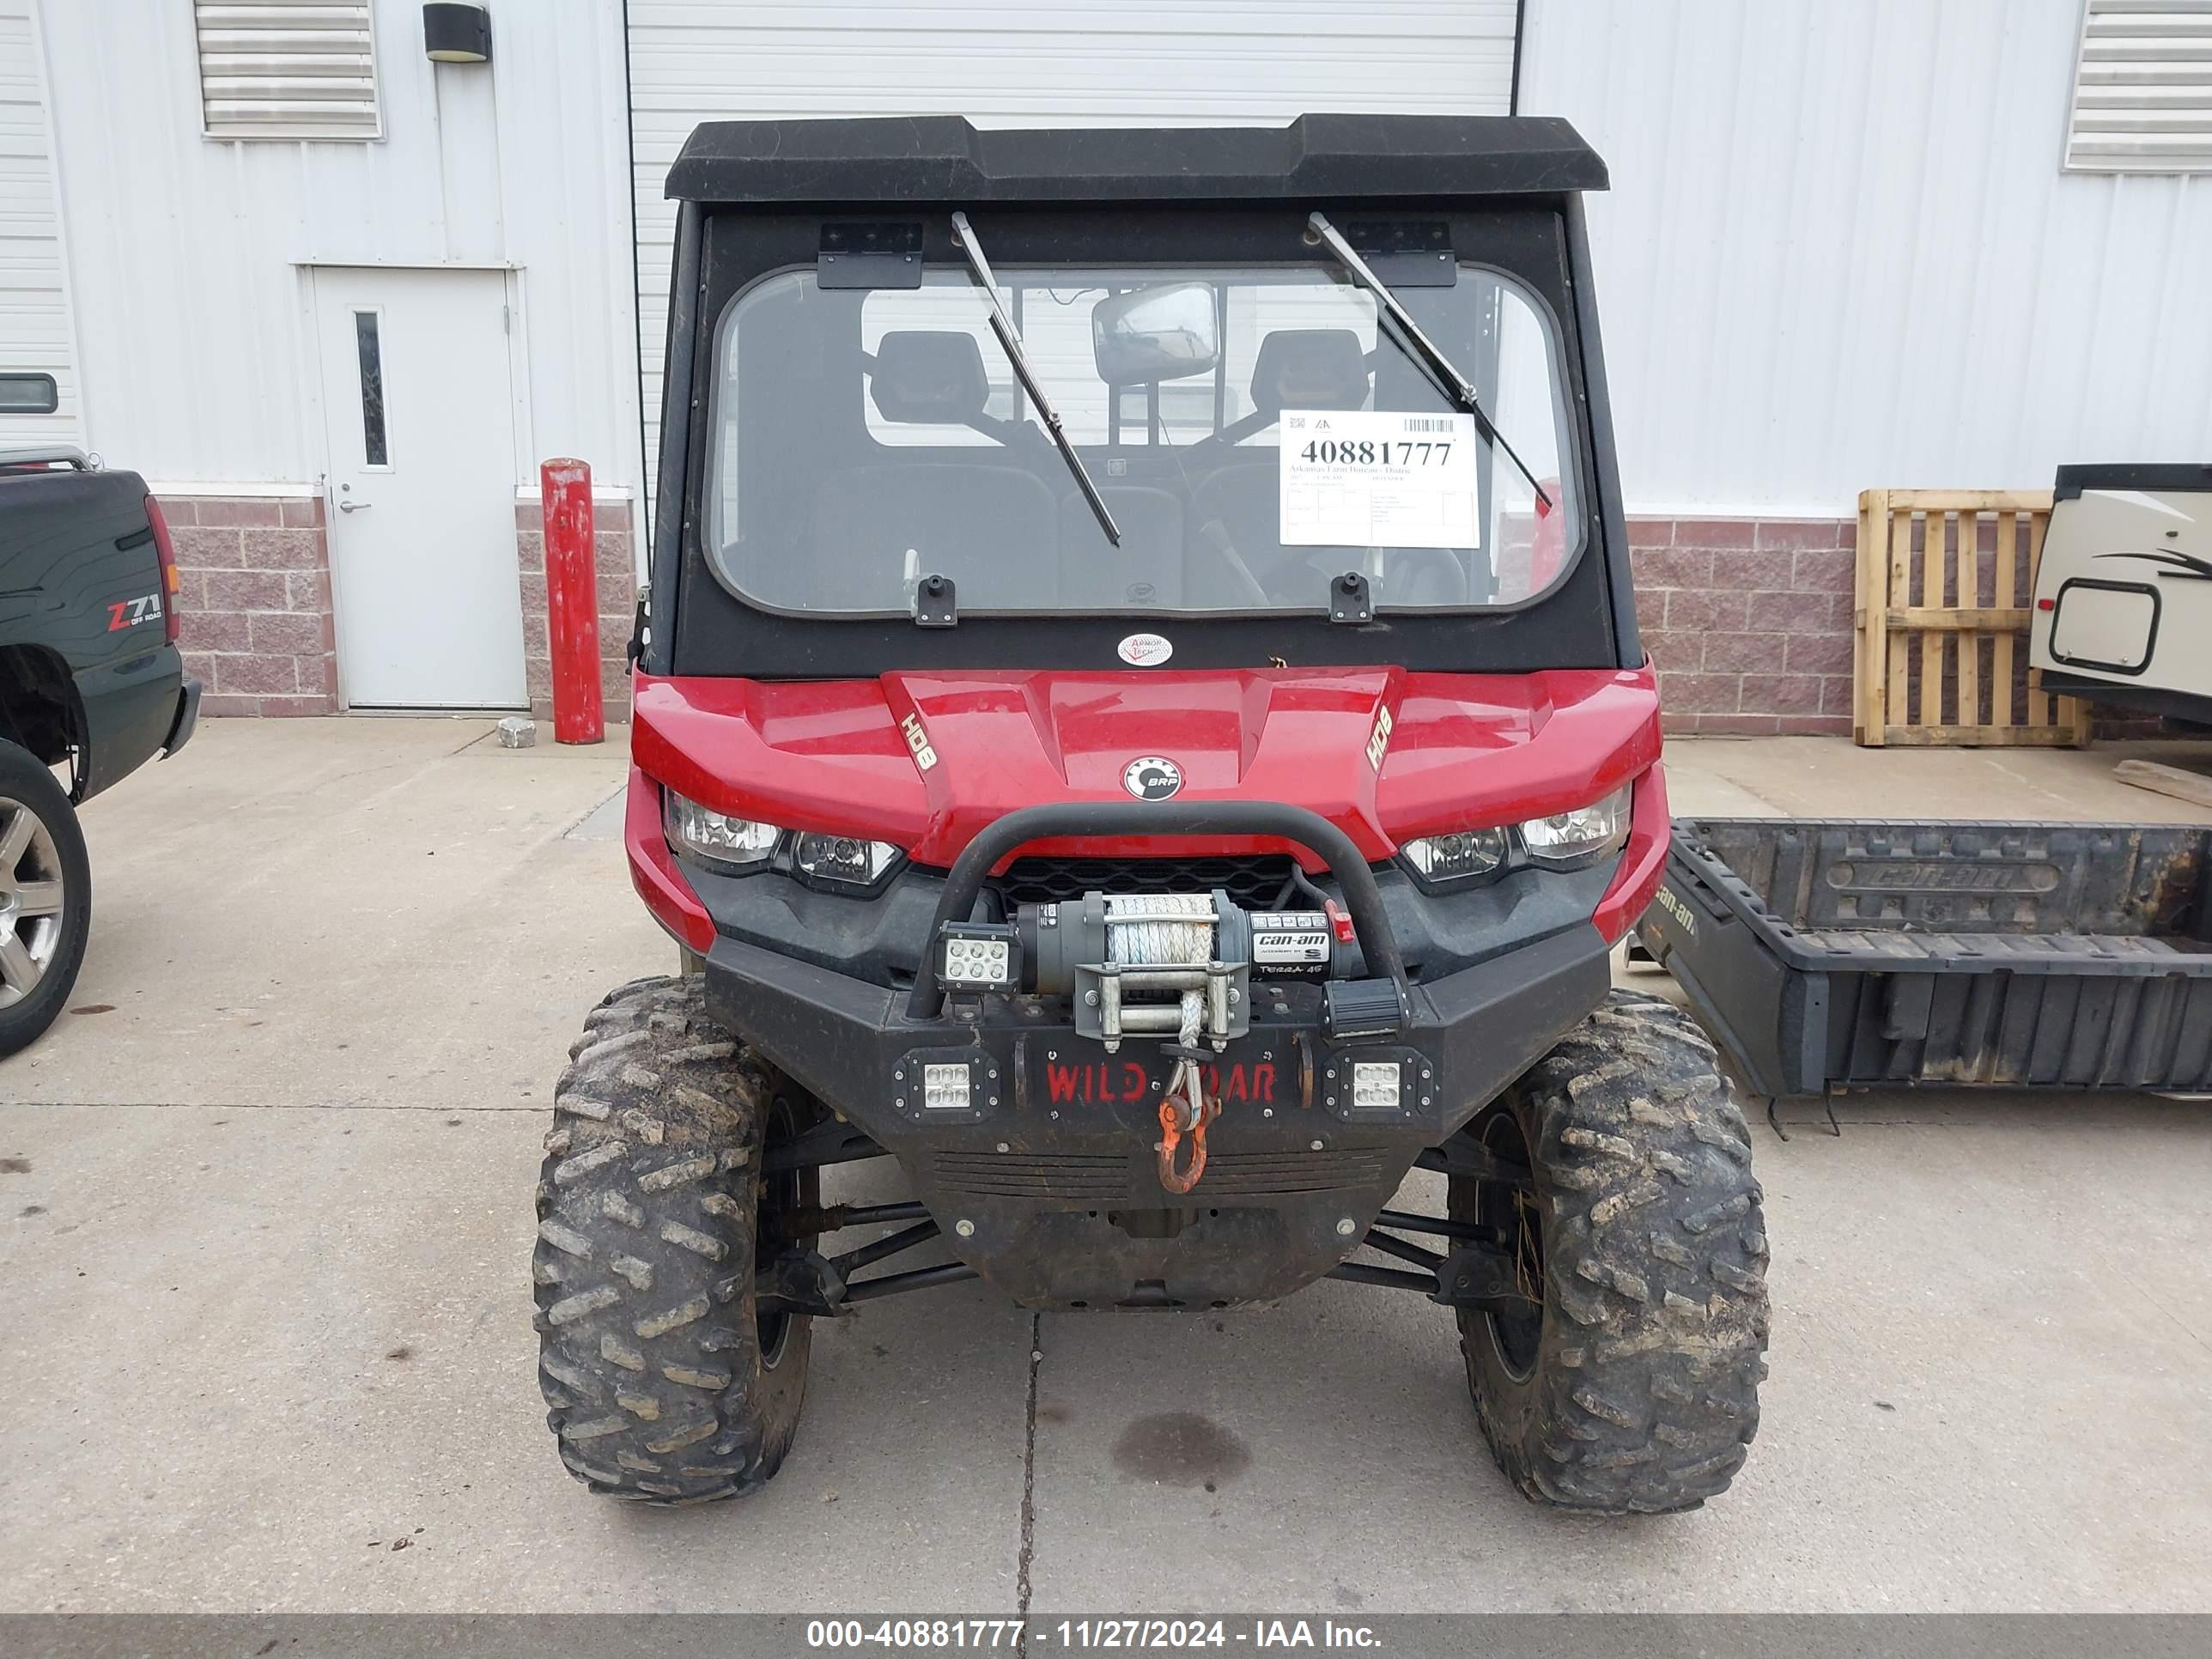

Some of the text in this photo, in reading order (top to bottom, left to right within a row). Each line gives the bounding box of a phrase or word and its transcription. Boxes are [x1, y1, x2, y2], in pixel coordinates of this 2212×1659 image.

[1301, 440, 1451, 465] 40881777
[107, 593, 161, 632] Z71
[131, 611, 161, 626] OFF ROAD
[901, 712, 938, 770] HD8
[1365, 704, 1393, 772] HD8
[1148, 778, 1178, 787] BRP
[1869, 863, 2014, 888] can-am
[1259, 935, 1326, 945] can-am
[1047, 1061, 1275, 1103] WILD OAR
